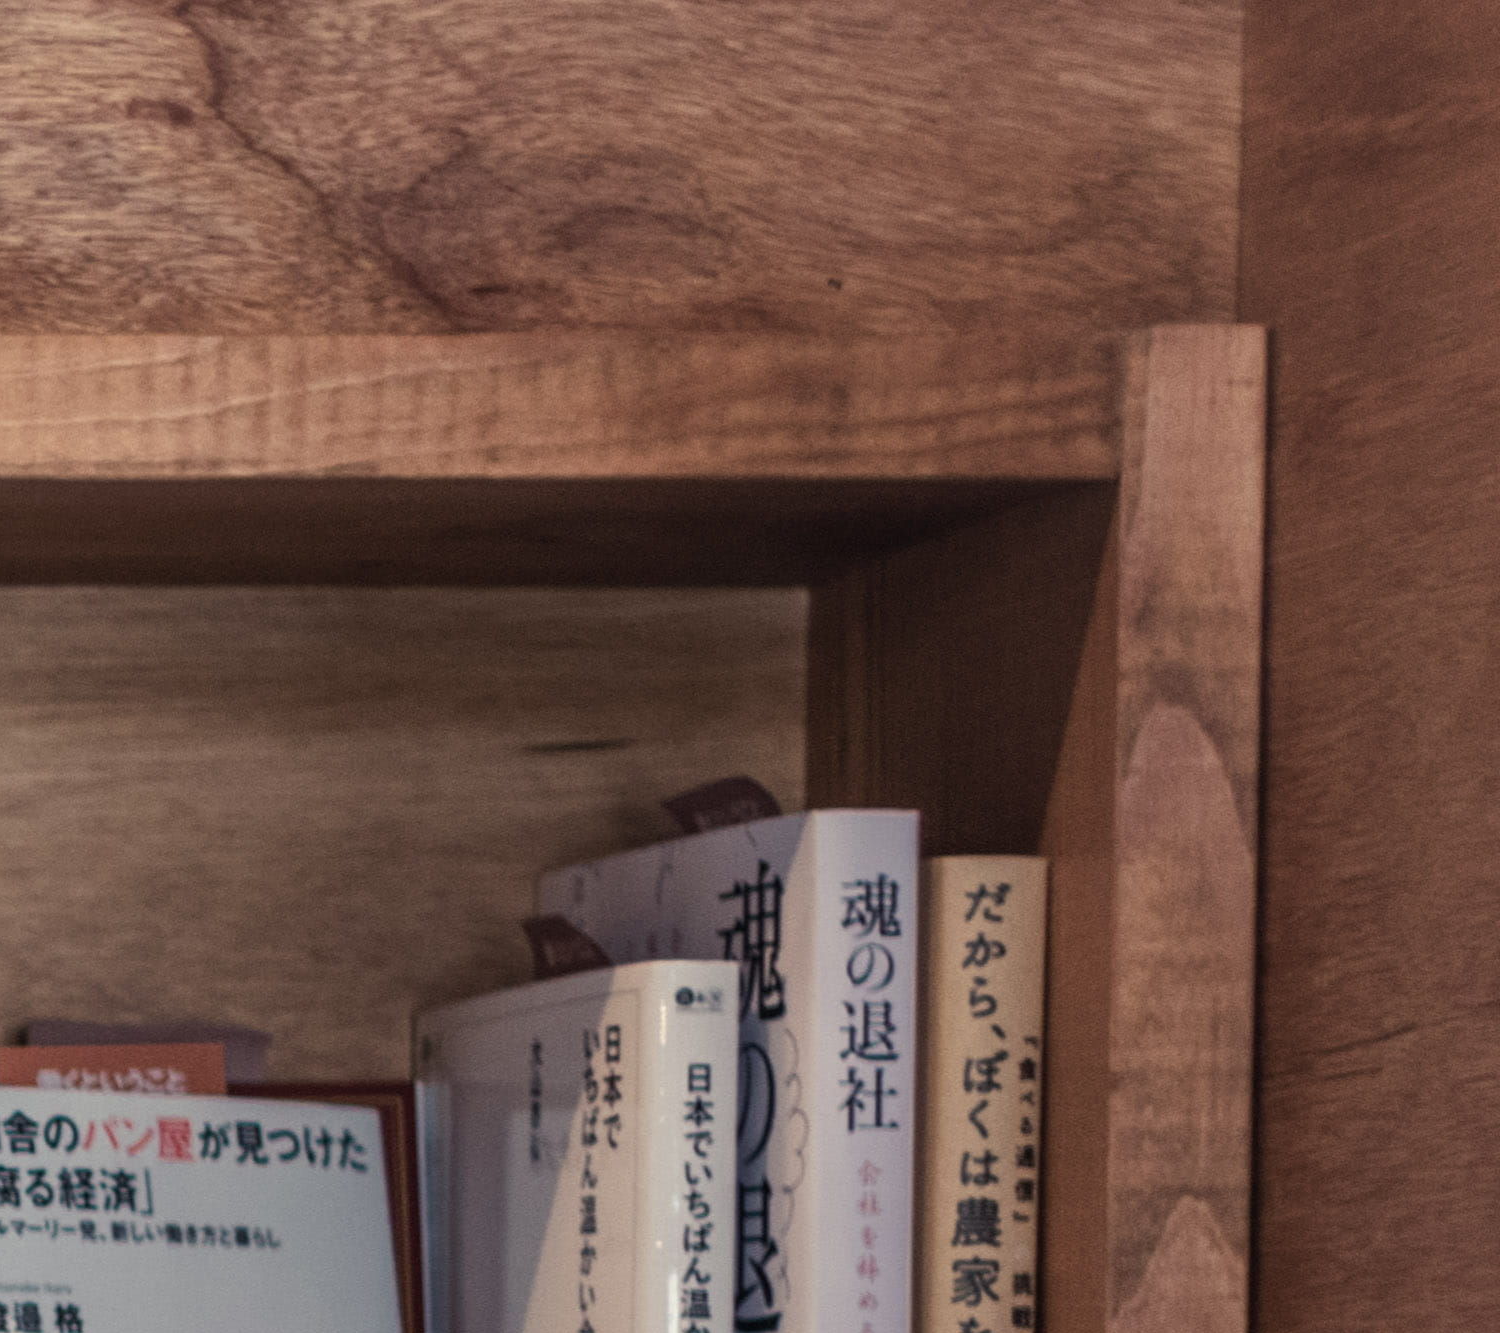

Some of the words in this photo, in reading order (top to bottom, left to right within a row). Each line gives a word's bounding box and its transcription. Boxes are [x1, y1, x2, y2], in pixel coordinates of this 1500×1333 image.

[603, 1023, 622, 1150] 日本で
[838, 872, 903, 1134] 魂の退社
